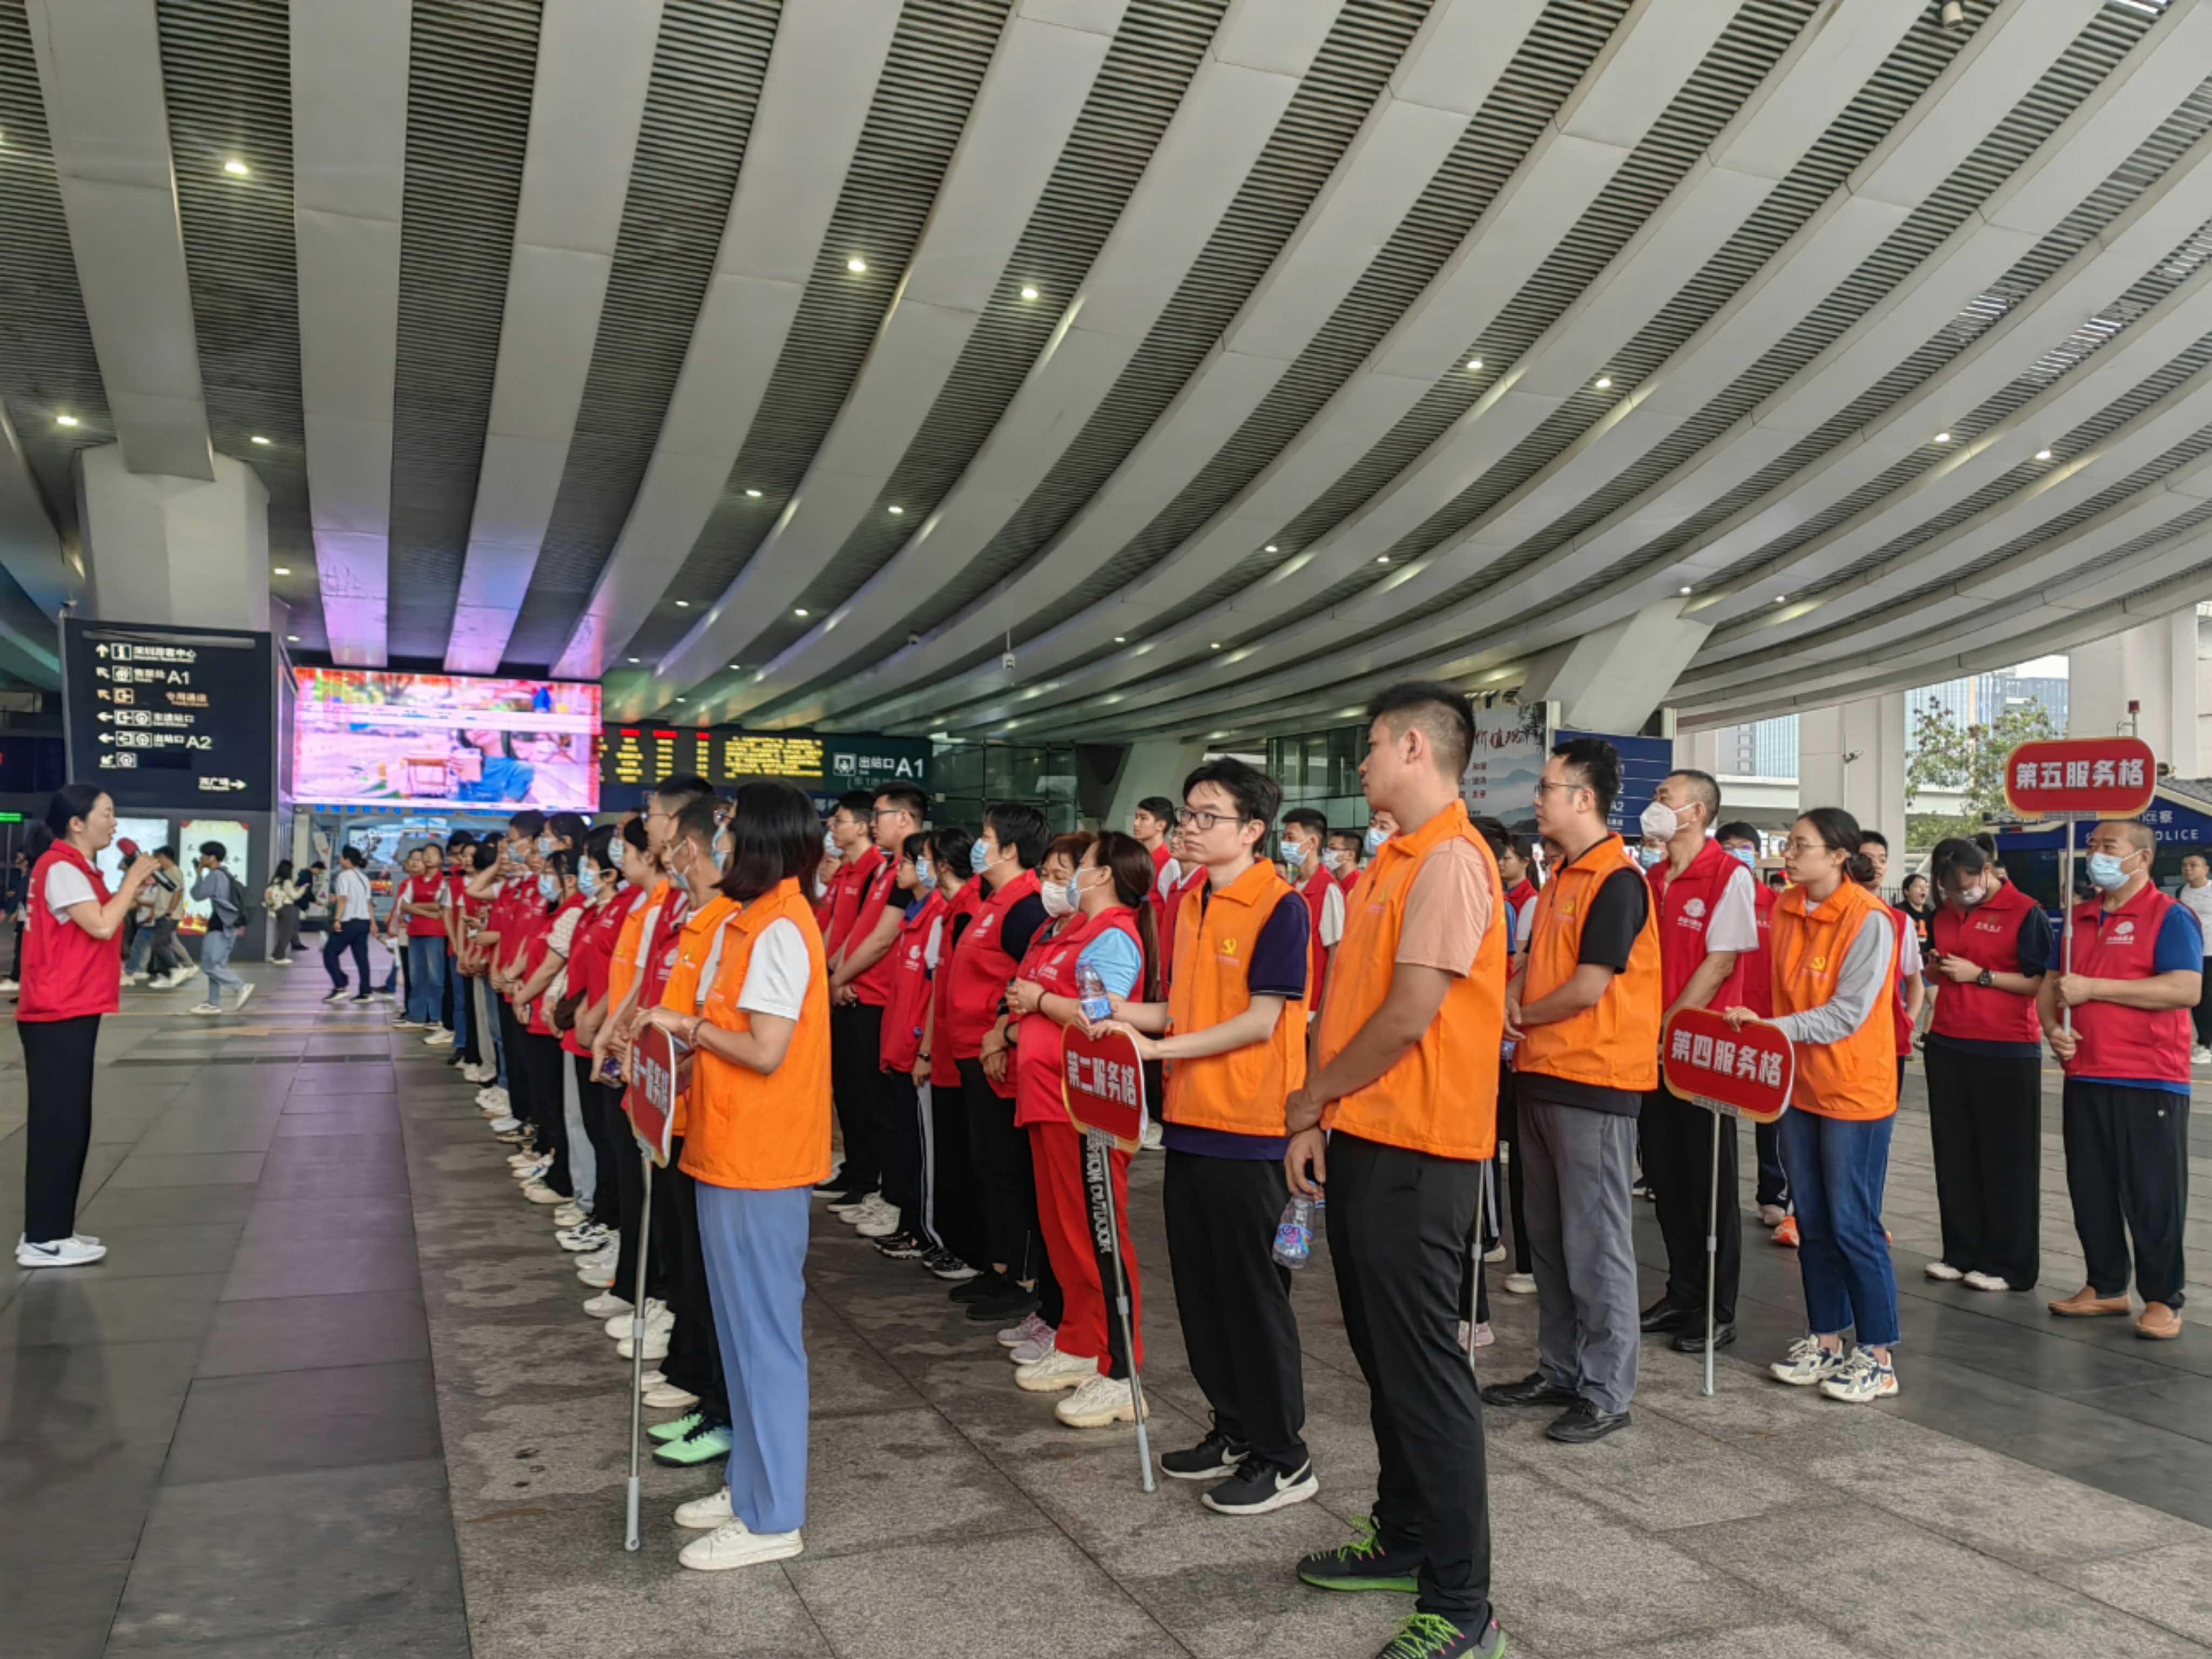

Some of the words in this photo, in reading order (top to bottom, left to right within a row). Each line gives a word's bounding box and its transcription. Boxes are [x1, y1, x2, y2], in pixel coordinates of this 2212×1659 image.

[167, 670, 190, 685] A1
[185, 736, 212, 750] A2
[894, 757, 923, 778] A1
[2015, 759, 2145, 790] 第五服务格
[2155, 829, 2199, 841] OLICE
[1671, 1028, 1784, 1086] 第四服务格
[1067, 1049, 1137, 1107] 第二服务格
